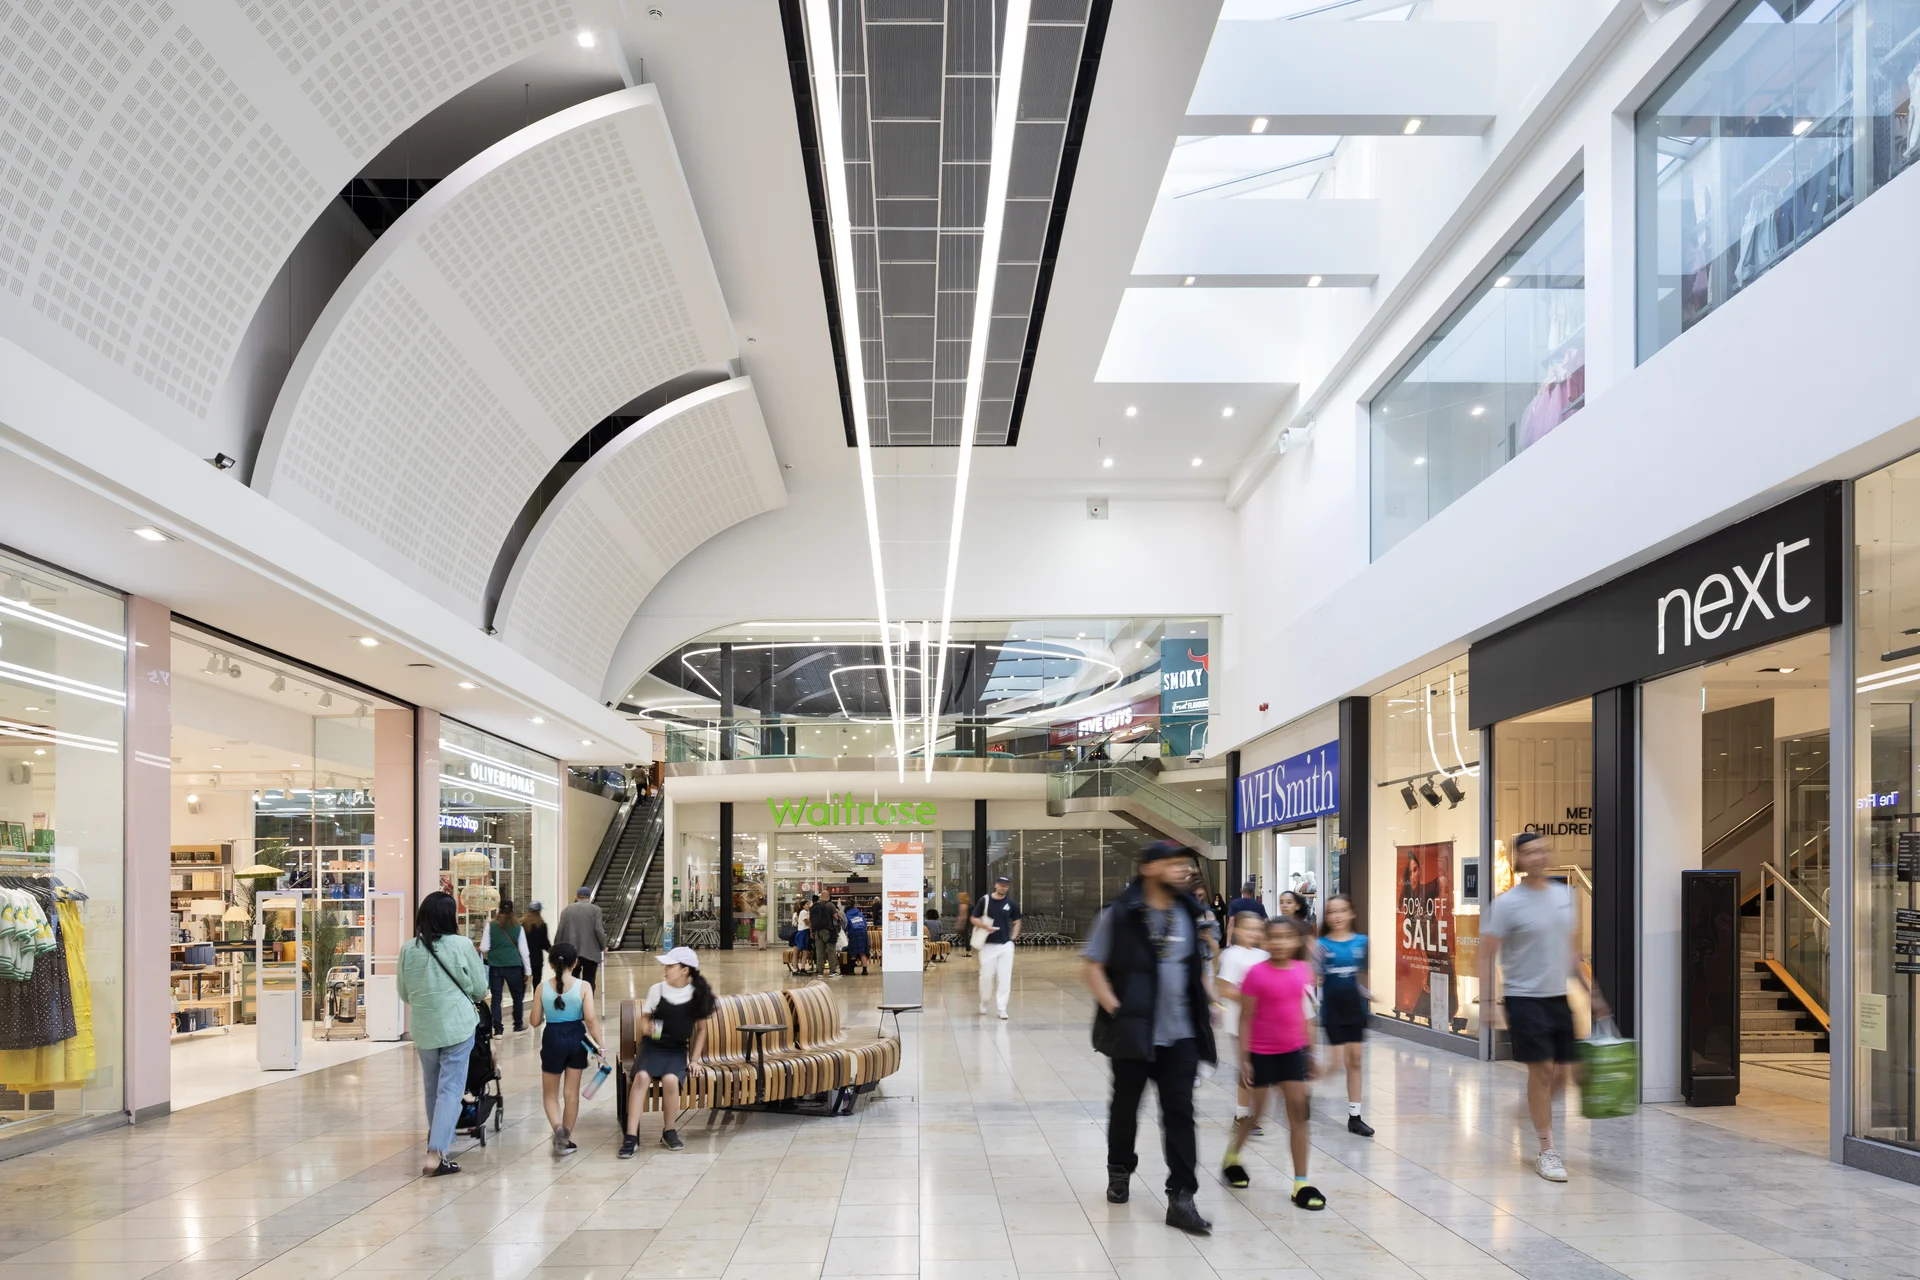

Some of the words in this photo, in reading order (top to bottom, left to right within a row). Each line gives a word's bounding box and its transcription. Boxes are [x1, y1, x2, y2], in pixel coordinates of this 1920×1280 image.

[1658, 537, 1811, 655] next
[1163, 668, 1204, 691] SMOKY
[1078, 717, 1103, 737] FIVE
[1104, 707, 1133, 730] GUYS
[1240, 750, 1335, 829] WHSmith
[766, 791, 937, 828] Waitrose
[1403, 897, 1423, 916] 50%
[1426, 898, 1447, 917] OFF
[1403, 917, 1448, 953] SALE
